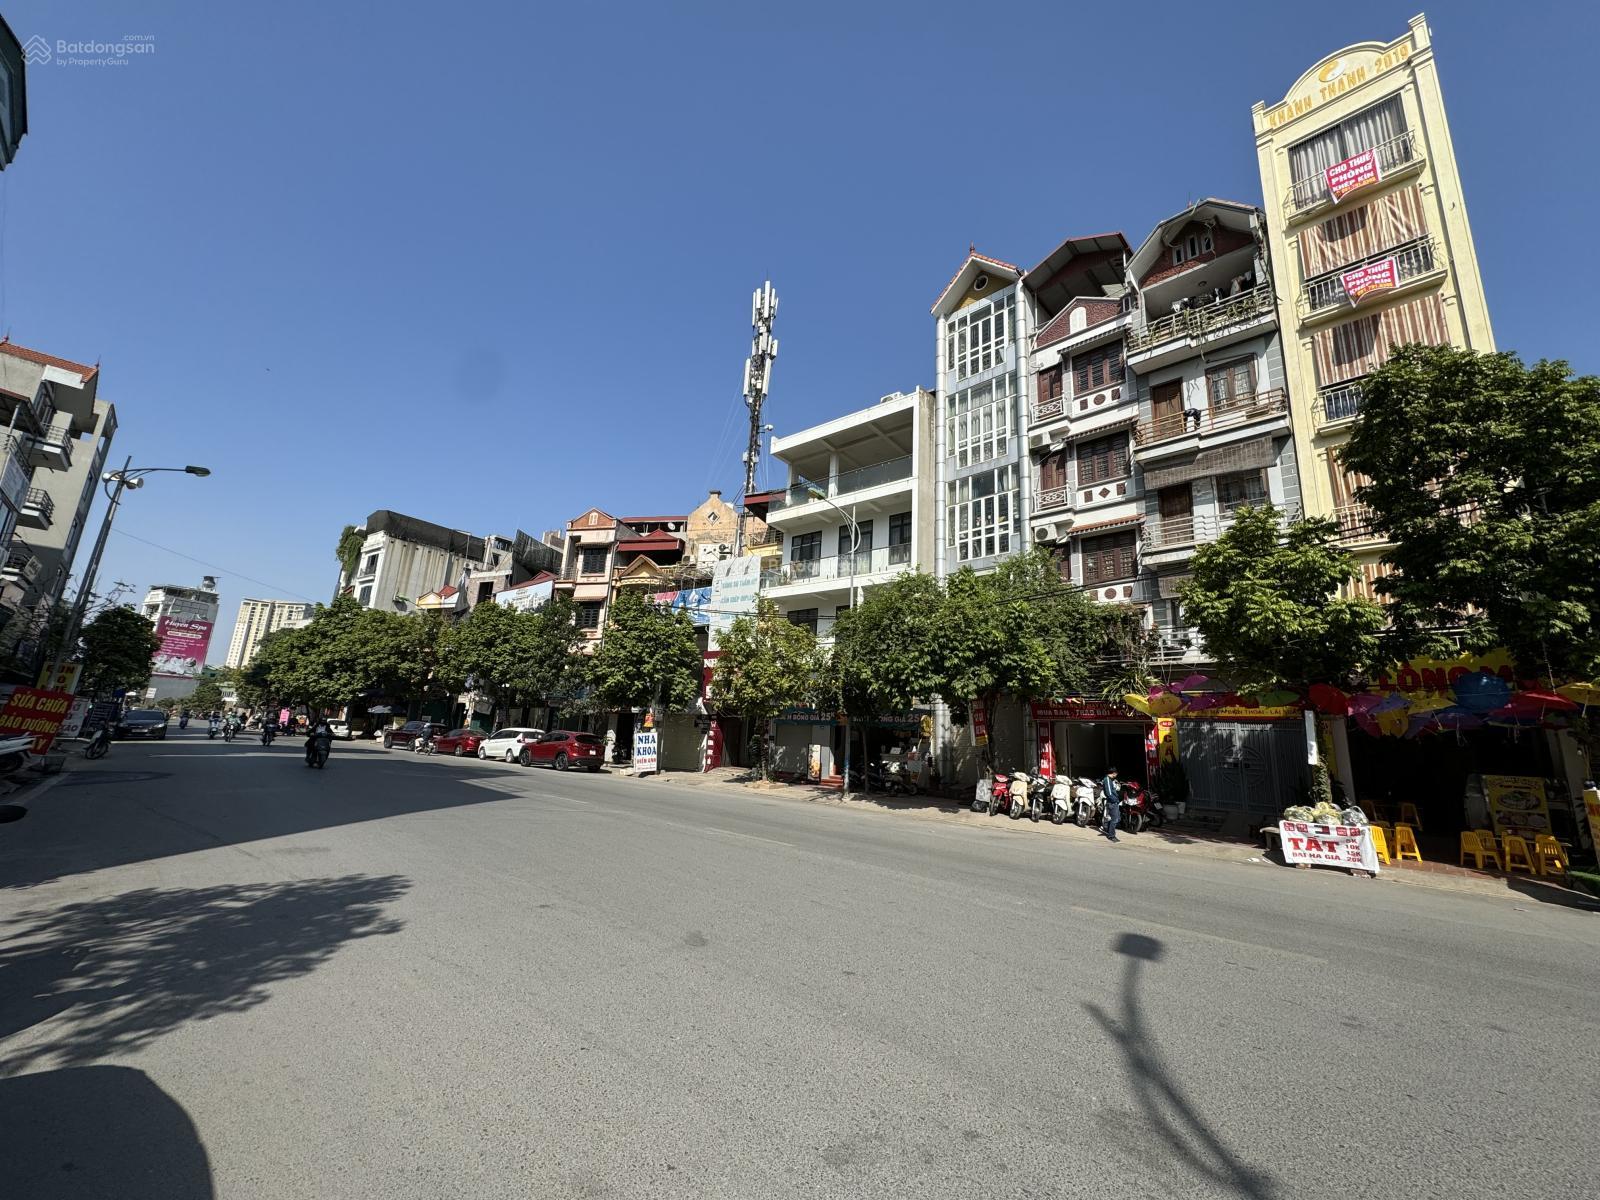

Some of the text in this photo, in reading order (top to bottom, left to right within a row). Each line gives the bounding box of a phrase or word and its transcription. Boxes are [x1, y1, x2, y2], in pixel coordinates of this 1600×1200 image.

[1329, 163, 1347, 176] CHO
[1332, 162, 1373, 185] PHÒNG
[1346, 271, 1365, 281] CHO
[10, 691, 69, 714] SỬA CHỮA
[637, 734, 656, 745] NHA
[636, 746, 656, 756] KHOA
